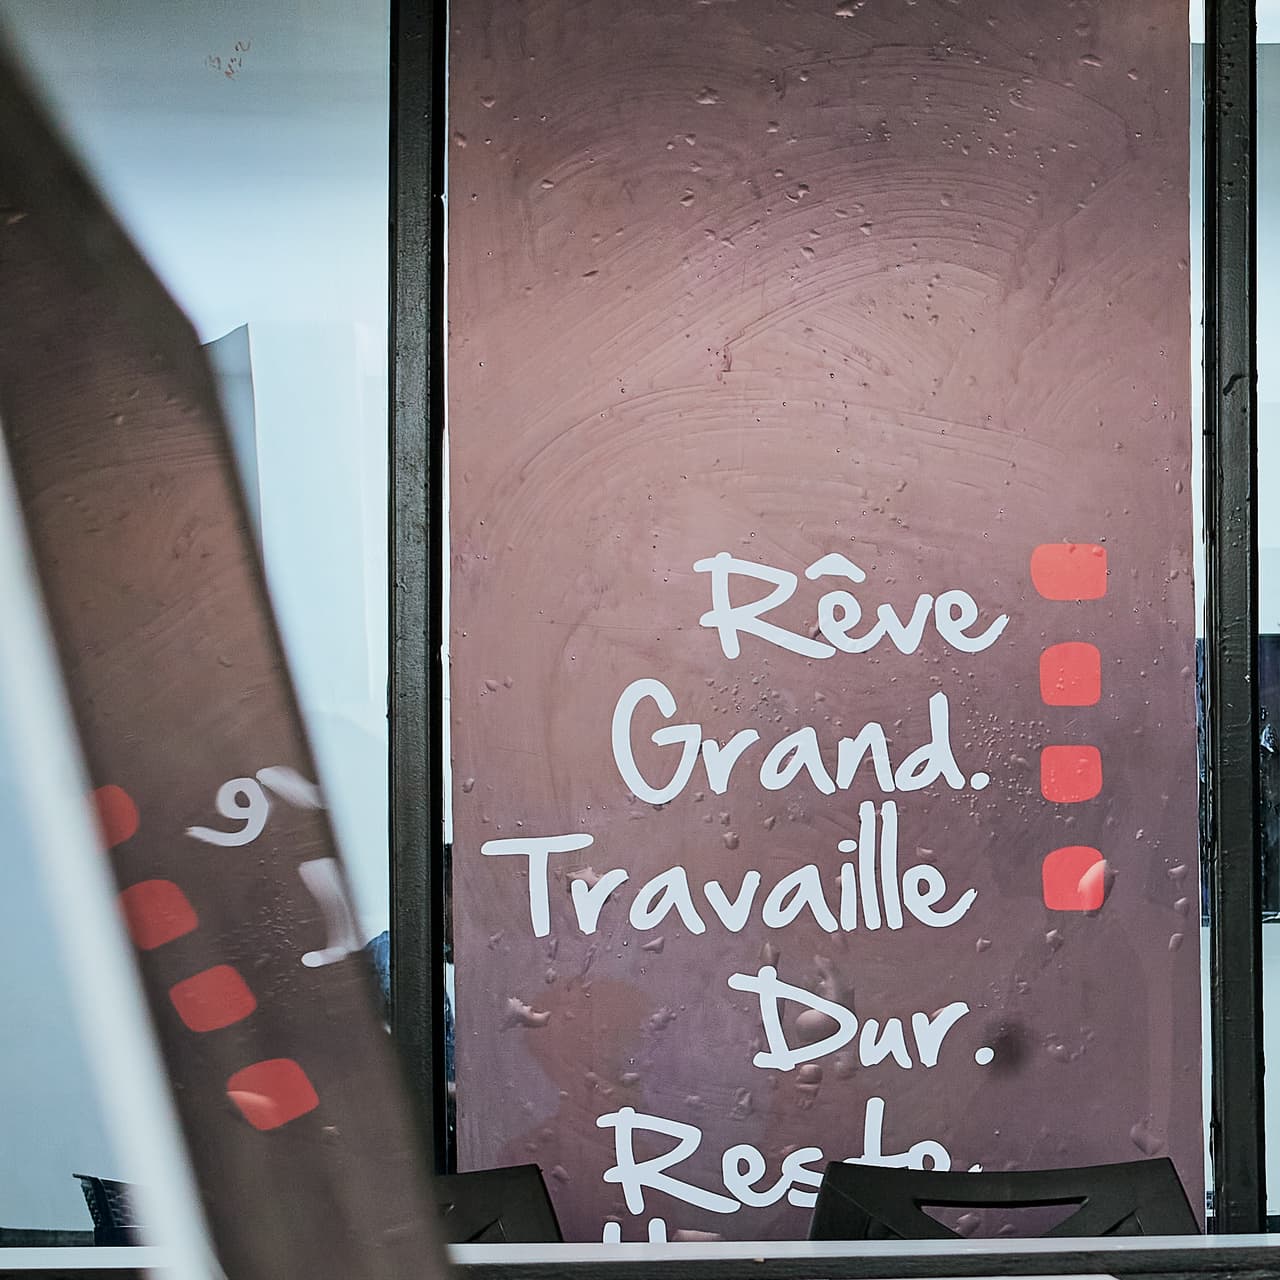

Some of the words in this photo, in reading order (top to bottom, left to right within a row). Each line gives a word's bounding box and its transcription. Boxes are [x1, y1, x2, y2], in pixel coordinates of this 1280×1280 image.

[692, 551, 1010, 660] Rêve
[611, 678, 990, 805] Grand.
[480, 800, 978, 938] Travaille
[727, 965, 995, 1072] Dur.
